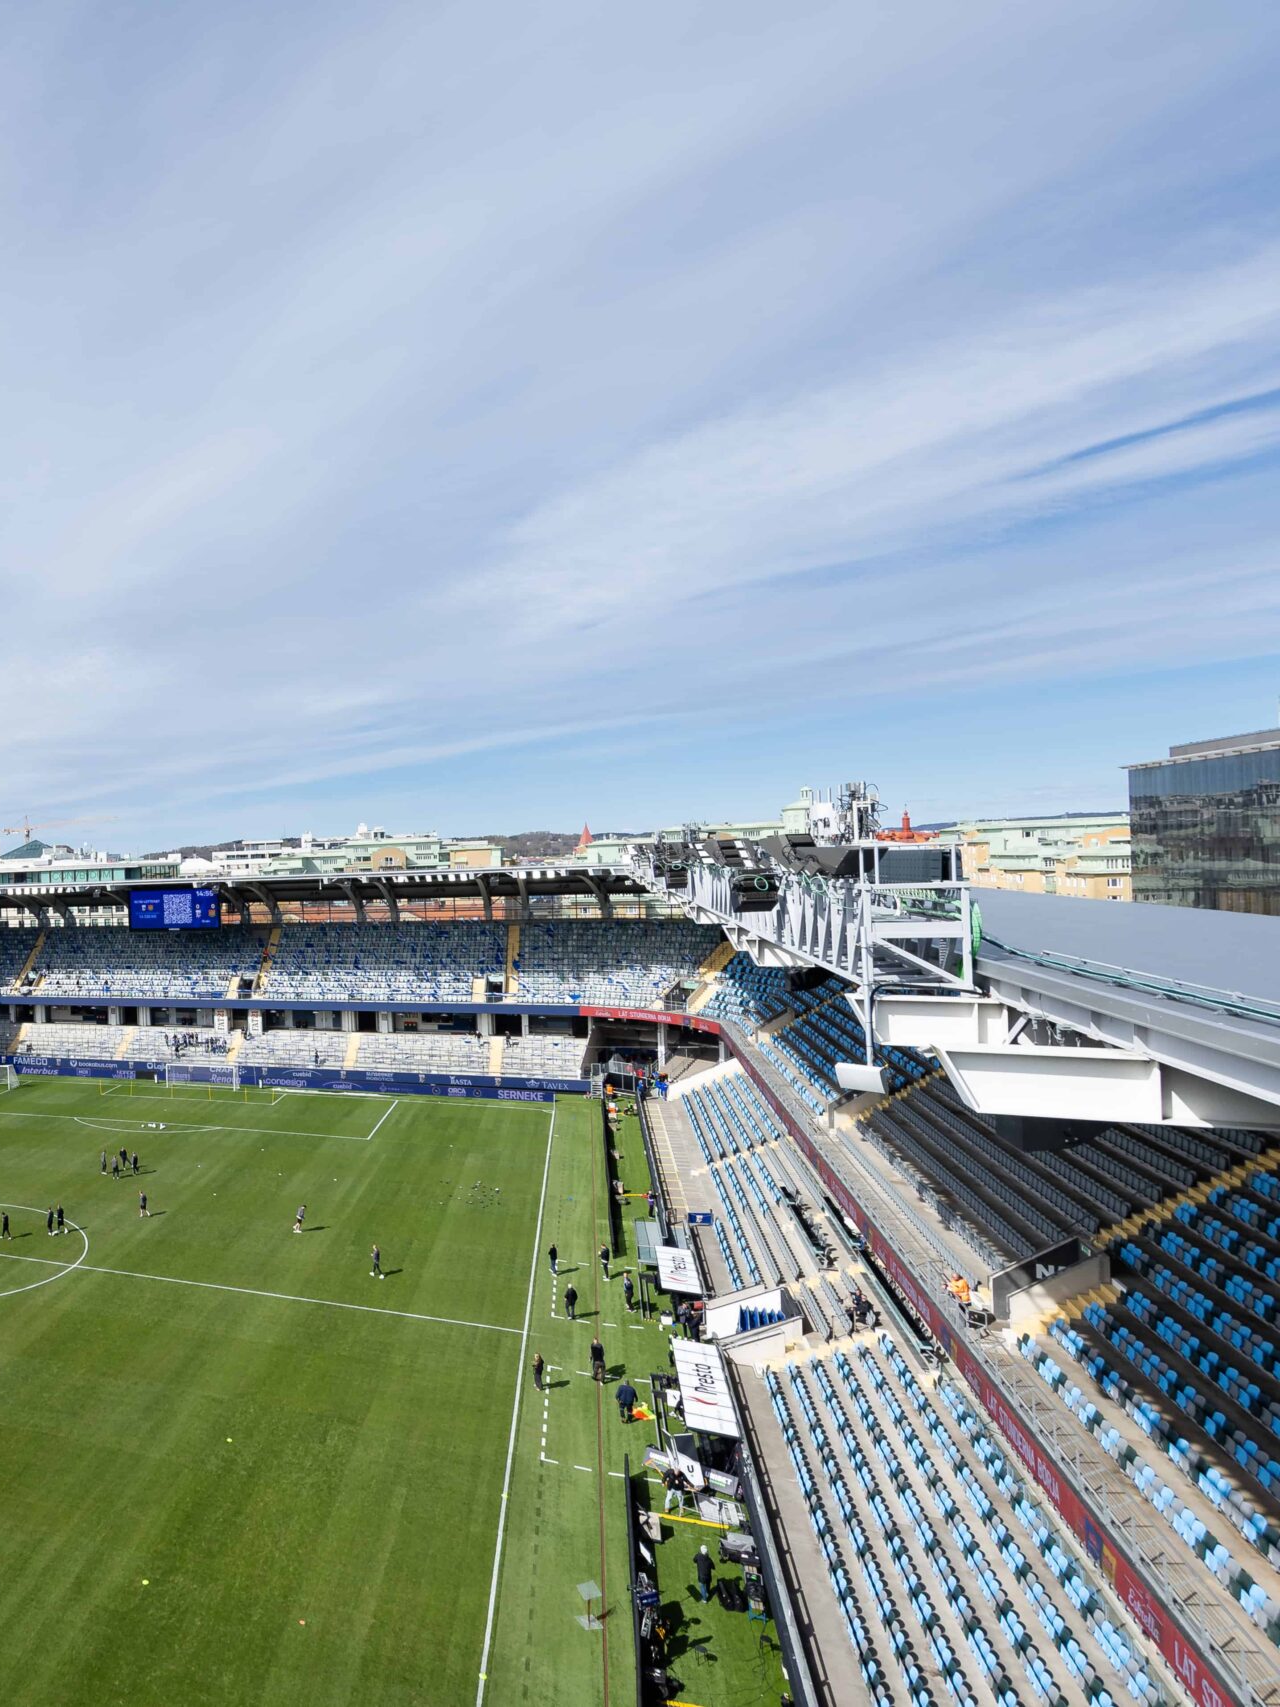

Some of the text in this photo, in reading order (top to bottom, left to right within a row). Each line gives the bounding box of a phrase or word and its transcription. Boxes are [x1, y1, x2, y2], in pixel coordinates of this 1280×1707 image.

[21, 1066, 59, 1075] Interbus
[543, 1081, 569, 1090] TAVEX
[497, 1089, 545, 1101] SERNEKE
[694, 1363, 718, 1396] Presto
[1174, 1640, 1198, 1690] LÅT
